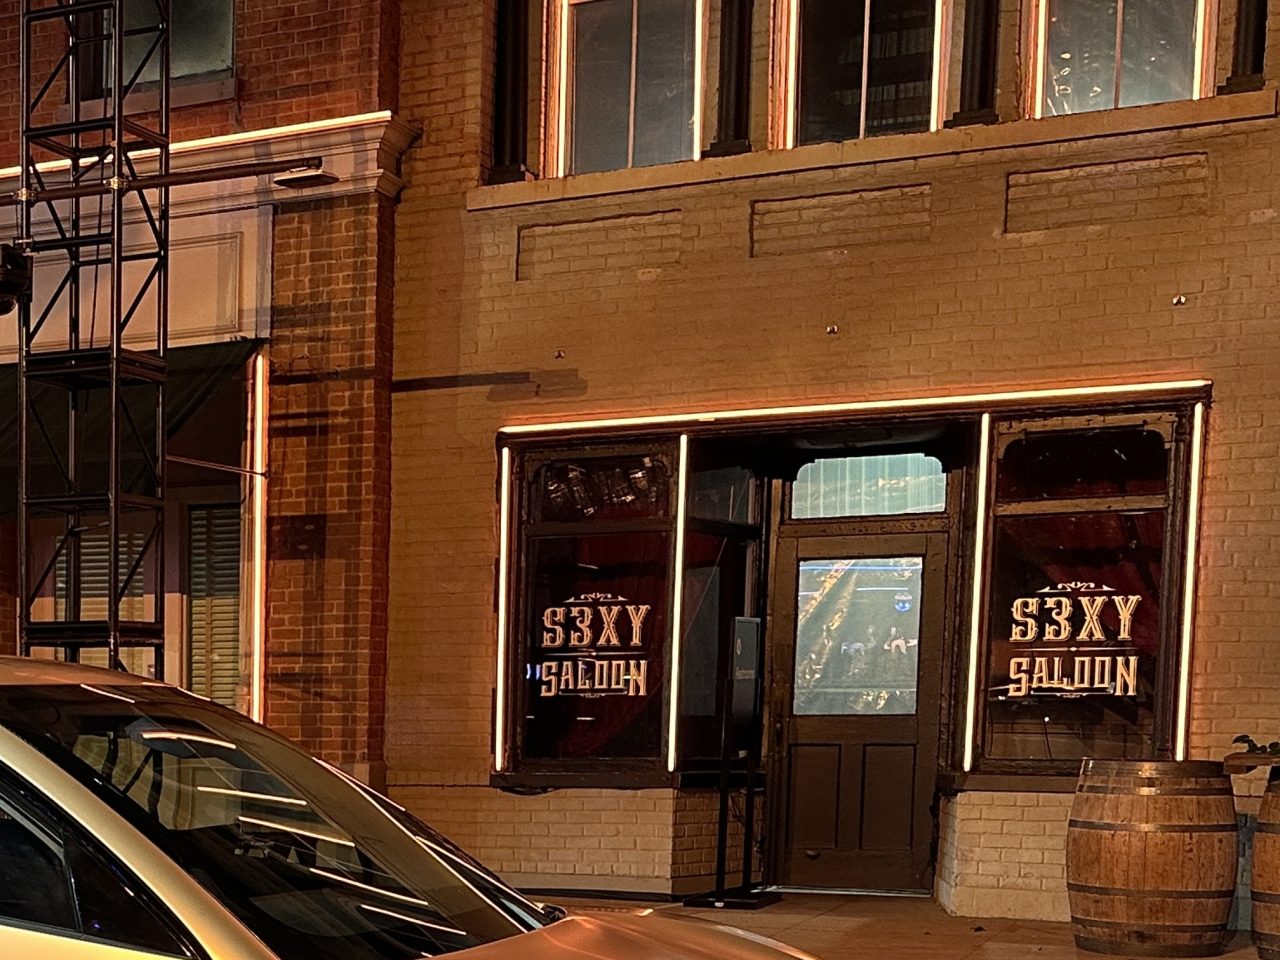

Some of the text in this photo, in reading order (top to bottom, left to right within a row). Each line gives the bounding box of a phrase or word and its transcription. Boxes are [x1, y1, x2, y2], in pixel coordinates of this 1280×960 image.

[542, 605, 651, 648] S3XY
[1009, 595, 1142, 642] S3XY
[540, 660, 648, 697] SALOON
[1007, 656, 1139, 697] SALOON
